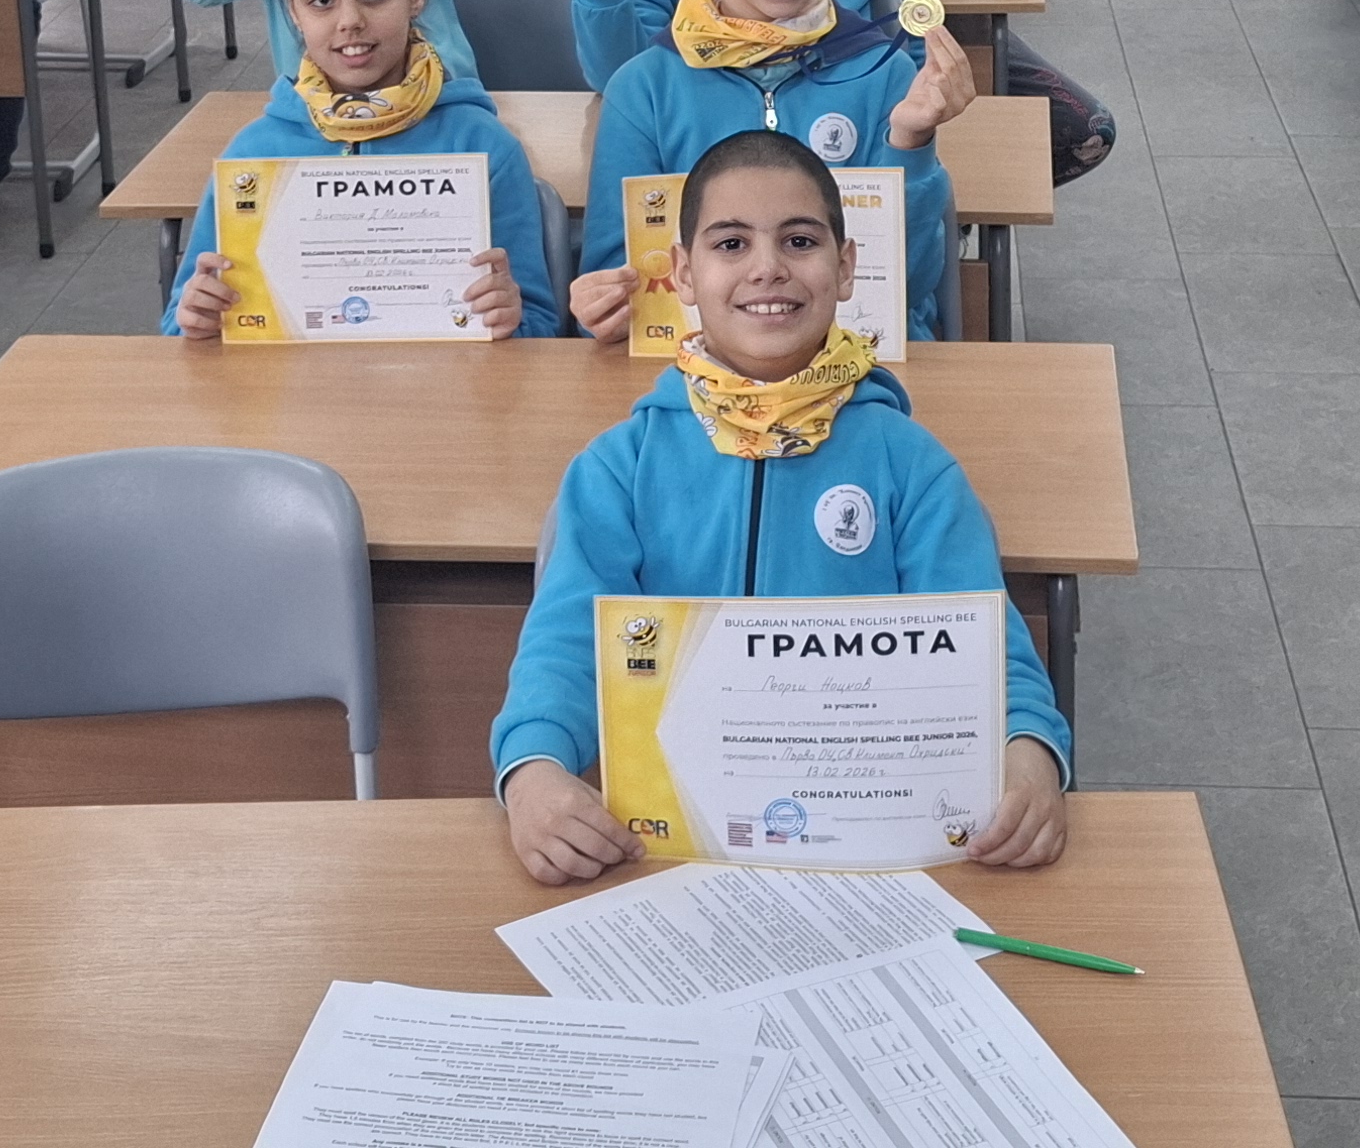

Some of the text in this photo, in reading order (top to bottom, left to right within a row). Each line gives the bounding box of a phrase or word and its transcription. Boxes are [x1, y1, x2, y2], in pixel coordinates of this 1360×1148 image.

[316, 179, 456, 197] ГРАМОТА
[842, 195, 882, 208] NER
[725, 612, 976, 627] BULGARIAN NATIONAL ENGLISH SPELLING BEE
[748, 629, 956, 657] ГРАМОТА
[761, 675, 806, 697] Георги
[722, 736, 772, 744] BULGARIAN
[775, 736, 818, 744] NATIONAL
[821, 736, 858, 744] ENGLISH
[860, 735, 901, 743] SPELLING
[904, 734, 919, 742] BEE
[922, 732, 954, 741] JUNIOR
[792, 789, 913, 798] CONGRATULATIONS!
